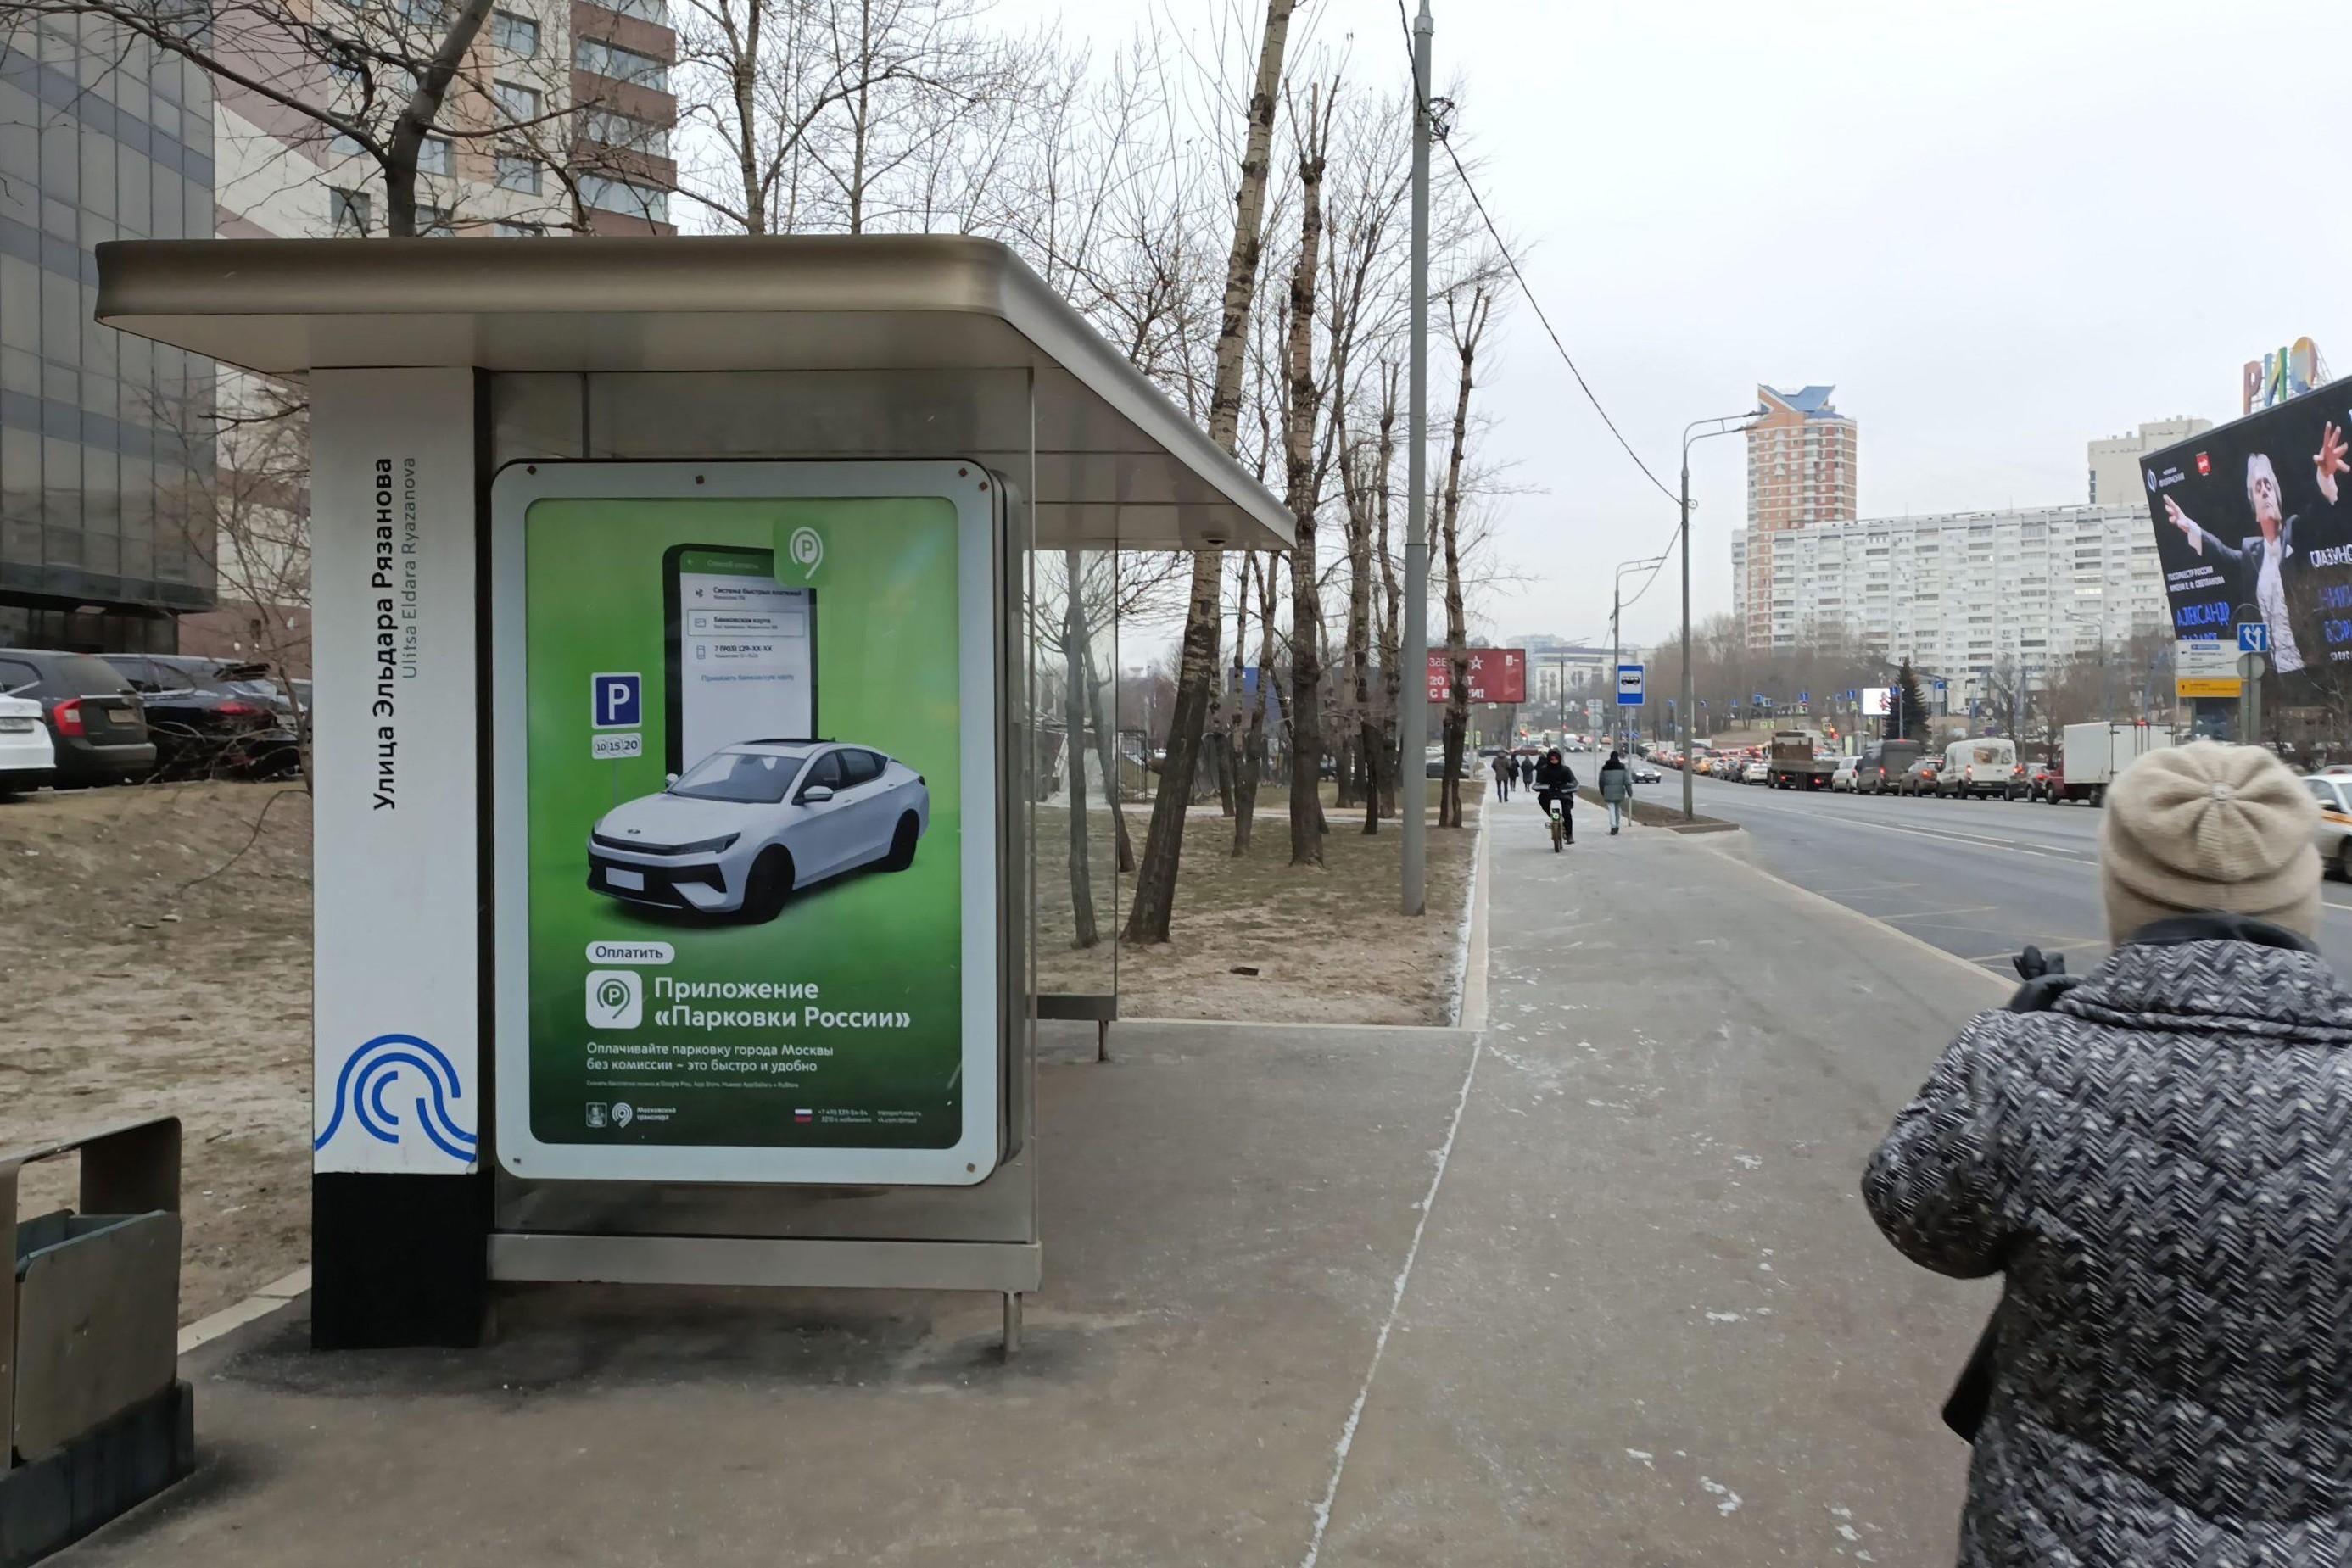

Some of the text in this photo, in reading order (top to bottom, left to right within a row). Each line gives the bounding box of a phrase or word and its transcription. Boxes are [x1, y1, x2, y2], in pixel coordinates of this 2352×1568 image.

[2243, 336, 2317, 416] РИО
[401, 457, 419, 679] Ulitsa Eldara Ryazanova
[372, 458, 399, 811] Улица Эльдара Рязанова
[608, 683, 630, 721] P
[596, 739, 638, 751] 10 15 20
[595, 945, 664, 960] Оплатить
[654, 976, 819, 1002] Приложение
[654, 1006, 911, 1032] «Парковки России»
[586, 1041, 834, 1058] Оплачивайте парковку города Москвы
[586, 1058, 609, 1070] без
[612, 1060, 673, 1072] комиссии
[687, 1061, 707, 1071] это
[711, 1059, 757, 1074] быстро
[761, 1062, 768, 1072] и
[770, 1059, 818, 1074] удобно
